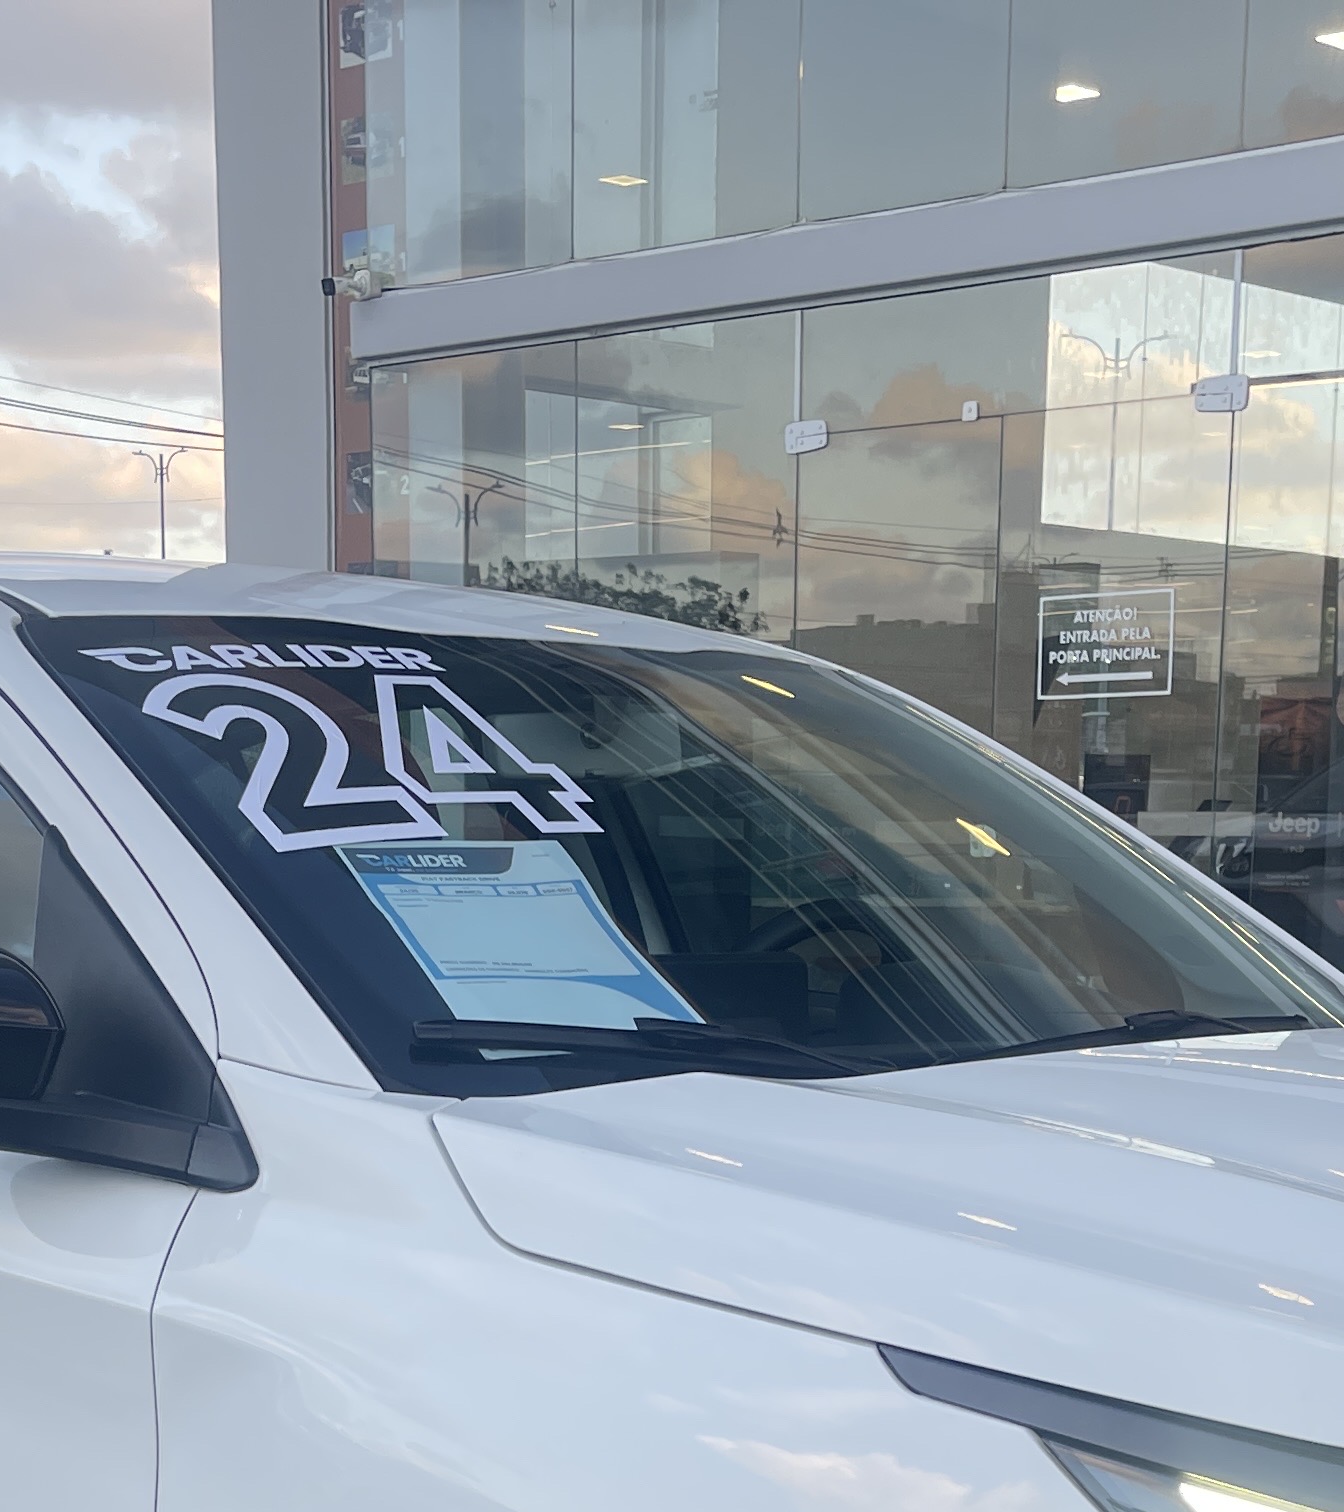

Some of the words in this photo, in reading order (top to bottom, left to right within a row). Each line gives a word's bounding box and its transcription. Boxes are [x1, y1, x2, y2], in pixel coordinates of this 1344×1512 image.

[1073, 604, 1138, 625] ATENÇÃO!
[1059, 628, 1118, 645] ENTRADA
[1121, 626, 1151, 641] PELA
[77, 643, 447, 672] CARLIDER
[1048, 649, 1090, 665] PORTA
[1093, 646, 1161, 663] PRINCIPAL.
[142, 673, 605, 853] 24
[1268, 811, 1321, 842] Jeep
[356, 853, 468, 868] CARLIDER
